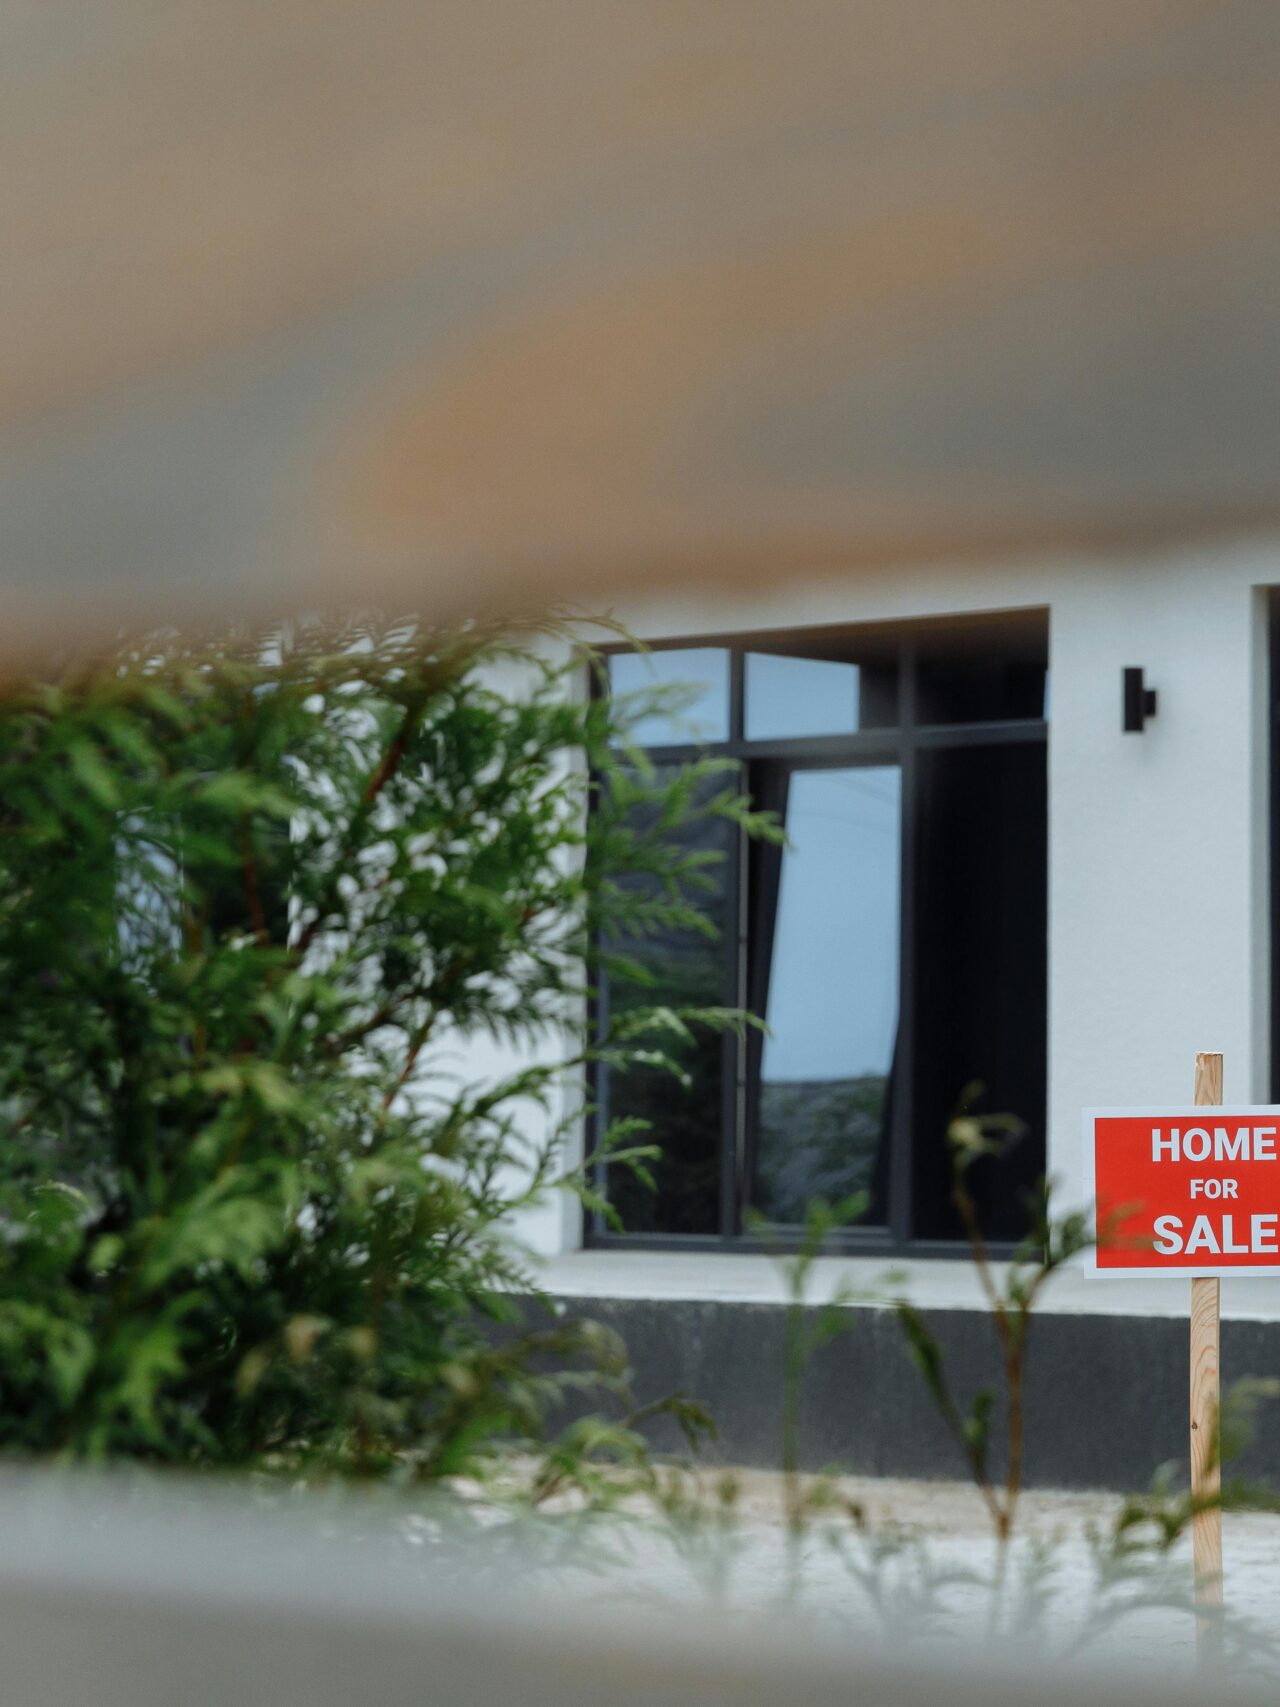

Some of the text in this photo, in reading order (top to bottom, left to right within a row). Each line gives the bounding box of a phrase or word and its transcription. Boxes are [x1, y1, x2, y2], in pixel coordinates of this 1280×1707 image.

[1151, 1127, 1277, 1162] HOME
[1190, 1178, 1239, 1199] FOR
[1152, 1213, 1279, 1255] SALE
